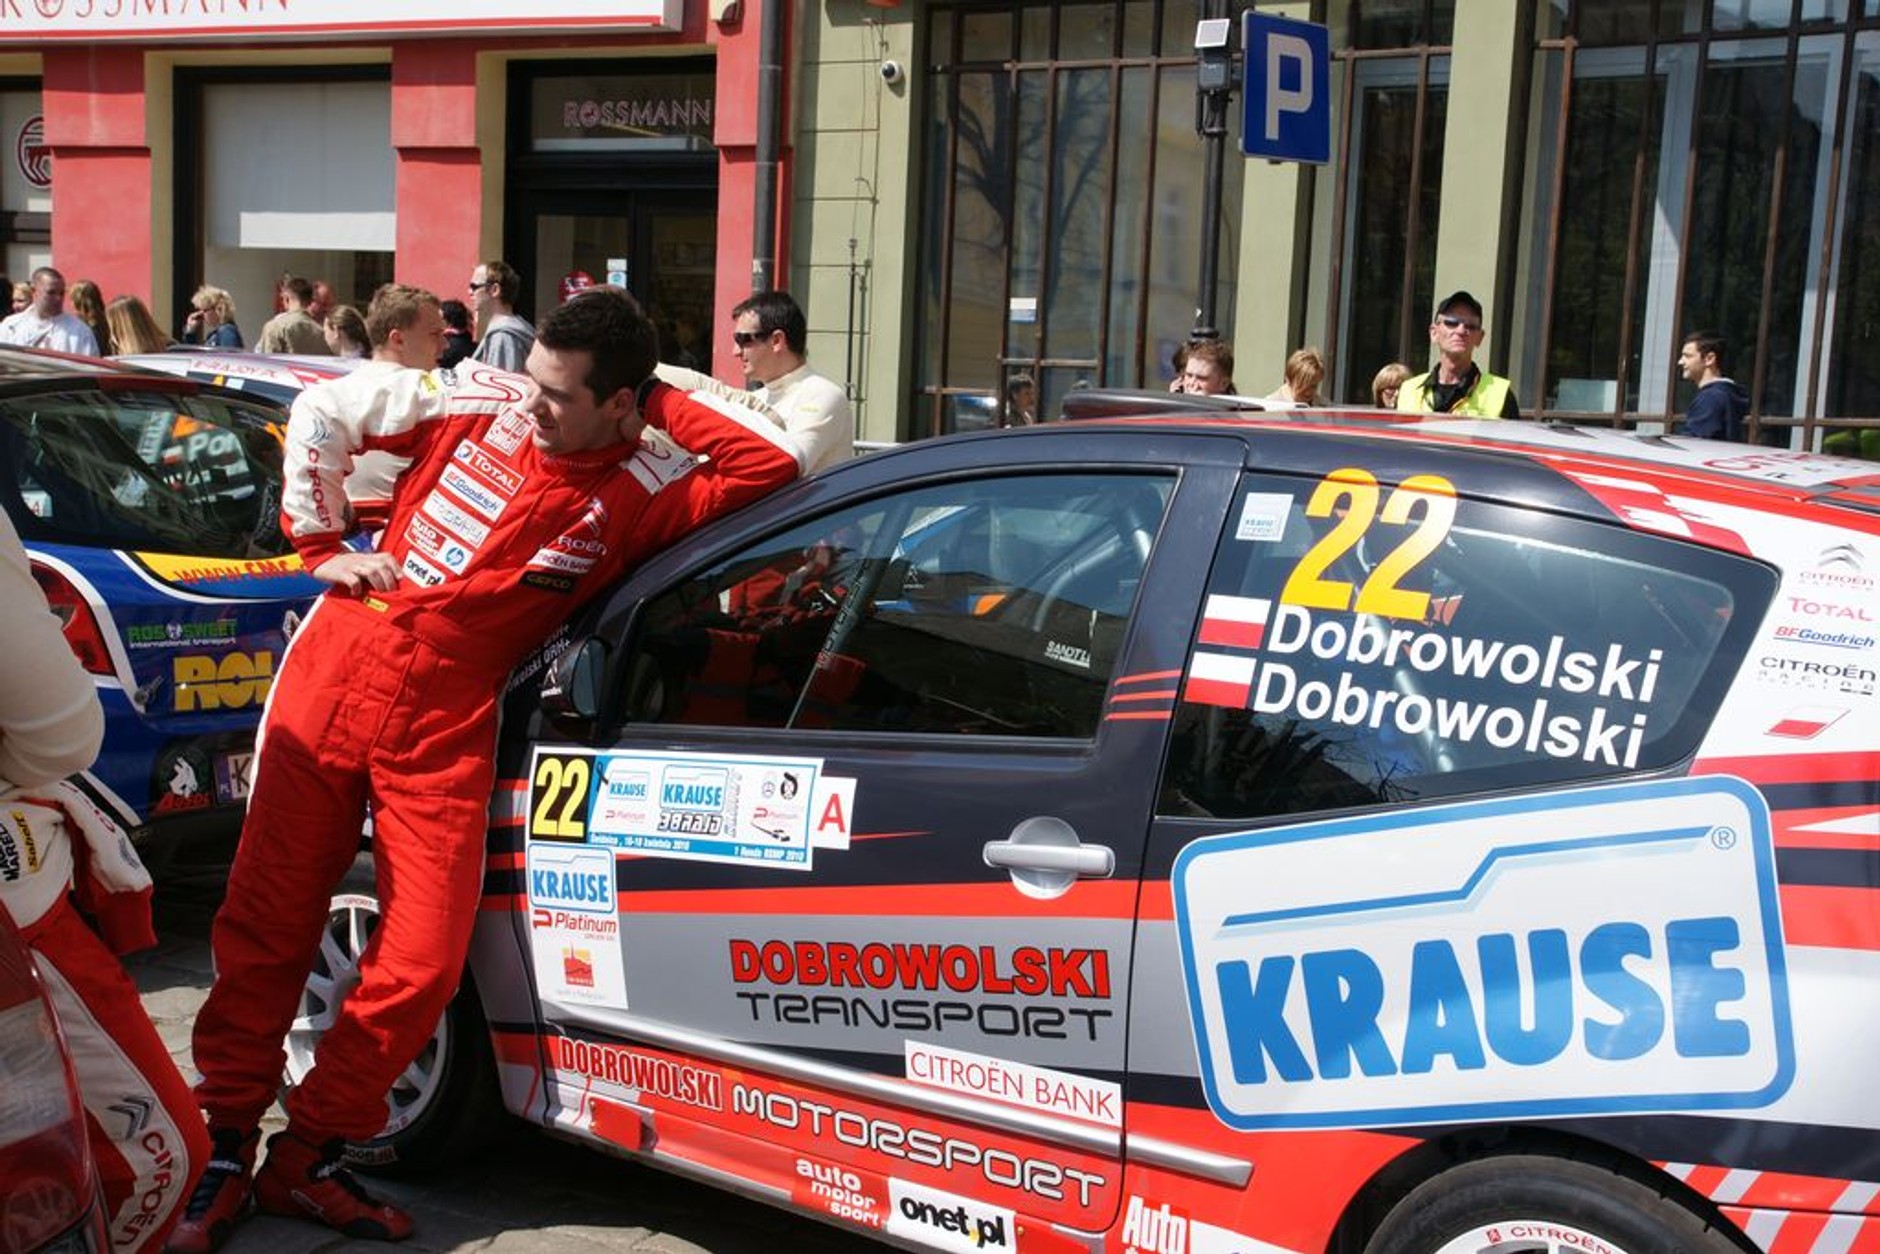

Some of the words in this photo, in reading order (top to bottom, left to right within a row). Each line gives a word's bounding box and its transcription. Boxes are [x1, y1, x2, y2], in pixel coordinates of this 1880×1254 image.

[1265, 32, 1314, 140] P
[563, 99, 712, 128] ROSSMANN
[473, 455, 518, 492] TOTAL
[1281, 467, 1458, 621] 22
[1788, 597, 1874, 622] TOTAL
[1267, 604, 1663, 703] Dobrowolski
[1774, 626, 1875, 648] BFGoodrich
[1760, 656, 1877, 682] CITROËN
[1254, 661, 1647, 769] Dobrowolski
[532, 757, 590, 837] 22
[609, 782, 646, 797] KRAUSE
[662, 783, 723, 807] KRAUSE
[817, 792, 846, 834] A
[532, 869, 609, 903] KRAUSE
[554, 911, 617, 934] Platinum
[730, 939, 1112, 999] DOBROWOLSKI
[736, 992, 1113, 1041] TRANSPORT
[1216, 916, 1752, 1085] KRAUSE
[559, 1036, 723, 1111] DOBROWOLSKI
[910, 1051, 1023, 1099] CITROËN
[1035, 1077, 1116, 1120] BANK
[732, 1083, 1106, 1207] MOTORSPORT
[796, 1158, 862, 1191] auto
[810, 1181, 877, 1209] motor
[829, 1201, 880, 1227] sport
[900, 1197, 1006, 1249] onet.pl
[1122, 1194, 1187, 1254] Auto
